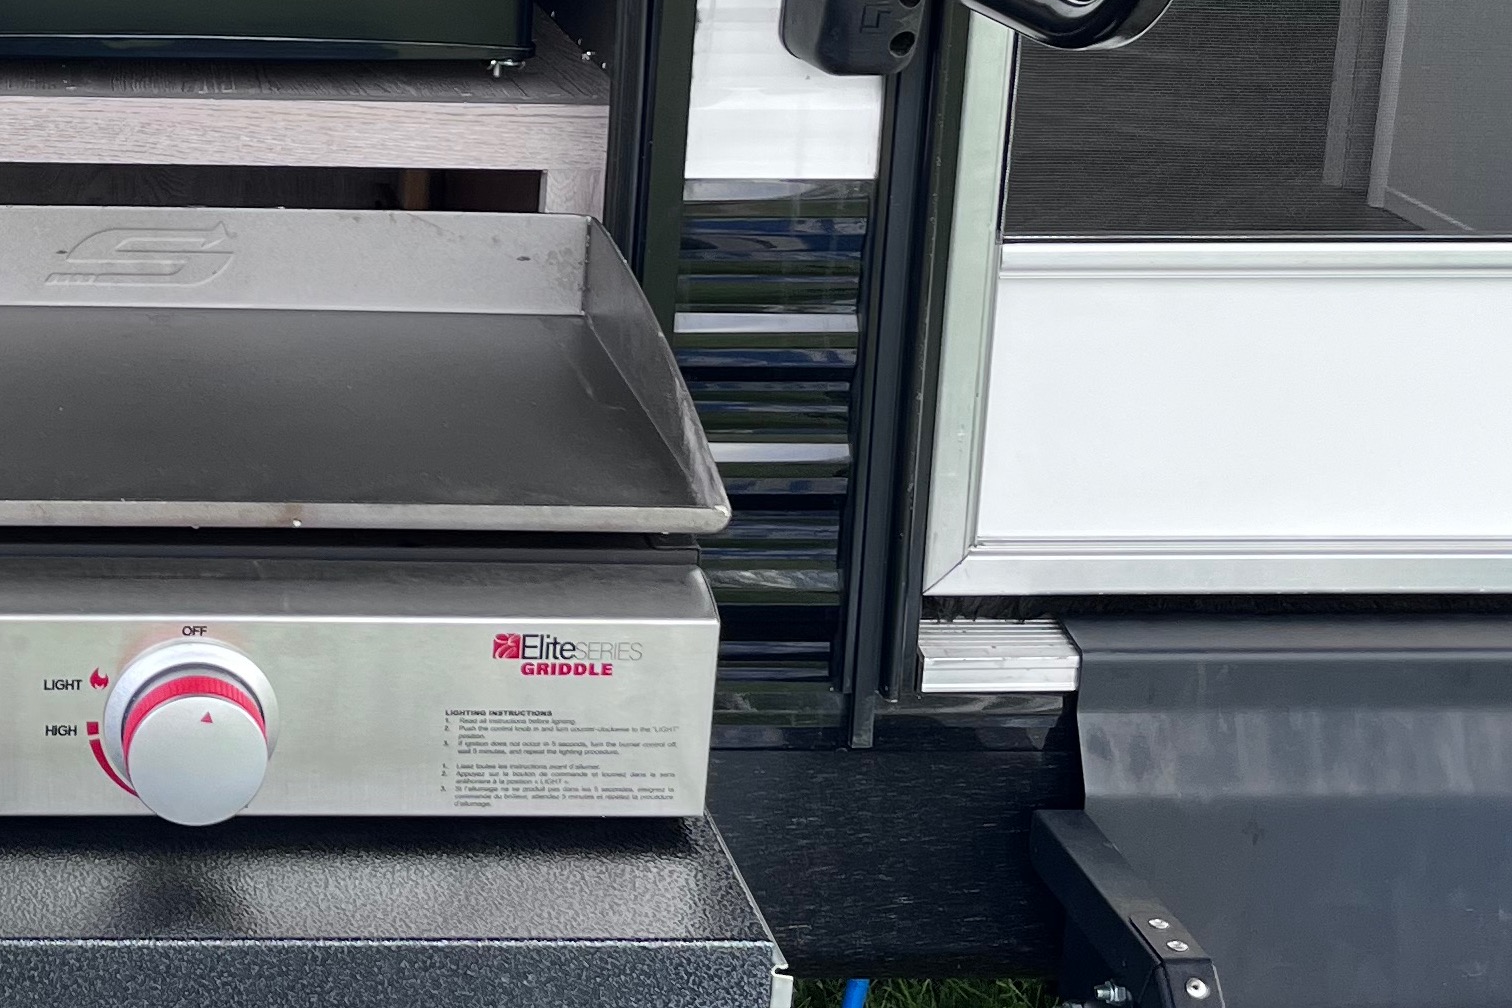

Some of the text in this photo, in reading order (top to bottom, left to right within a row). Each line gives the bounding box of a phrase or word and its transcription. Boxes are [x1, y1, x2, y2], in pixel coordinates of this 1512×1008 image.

[182, 626, 207, 637] OFF
[520, 661, 614, 676] GRIDDLE
[43, 679, 83, 691] LIGHT
[45, 725, 77, 736] HIGH
